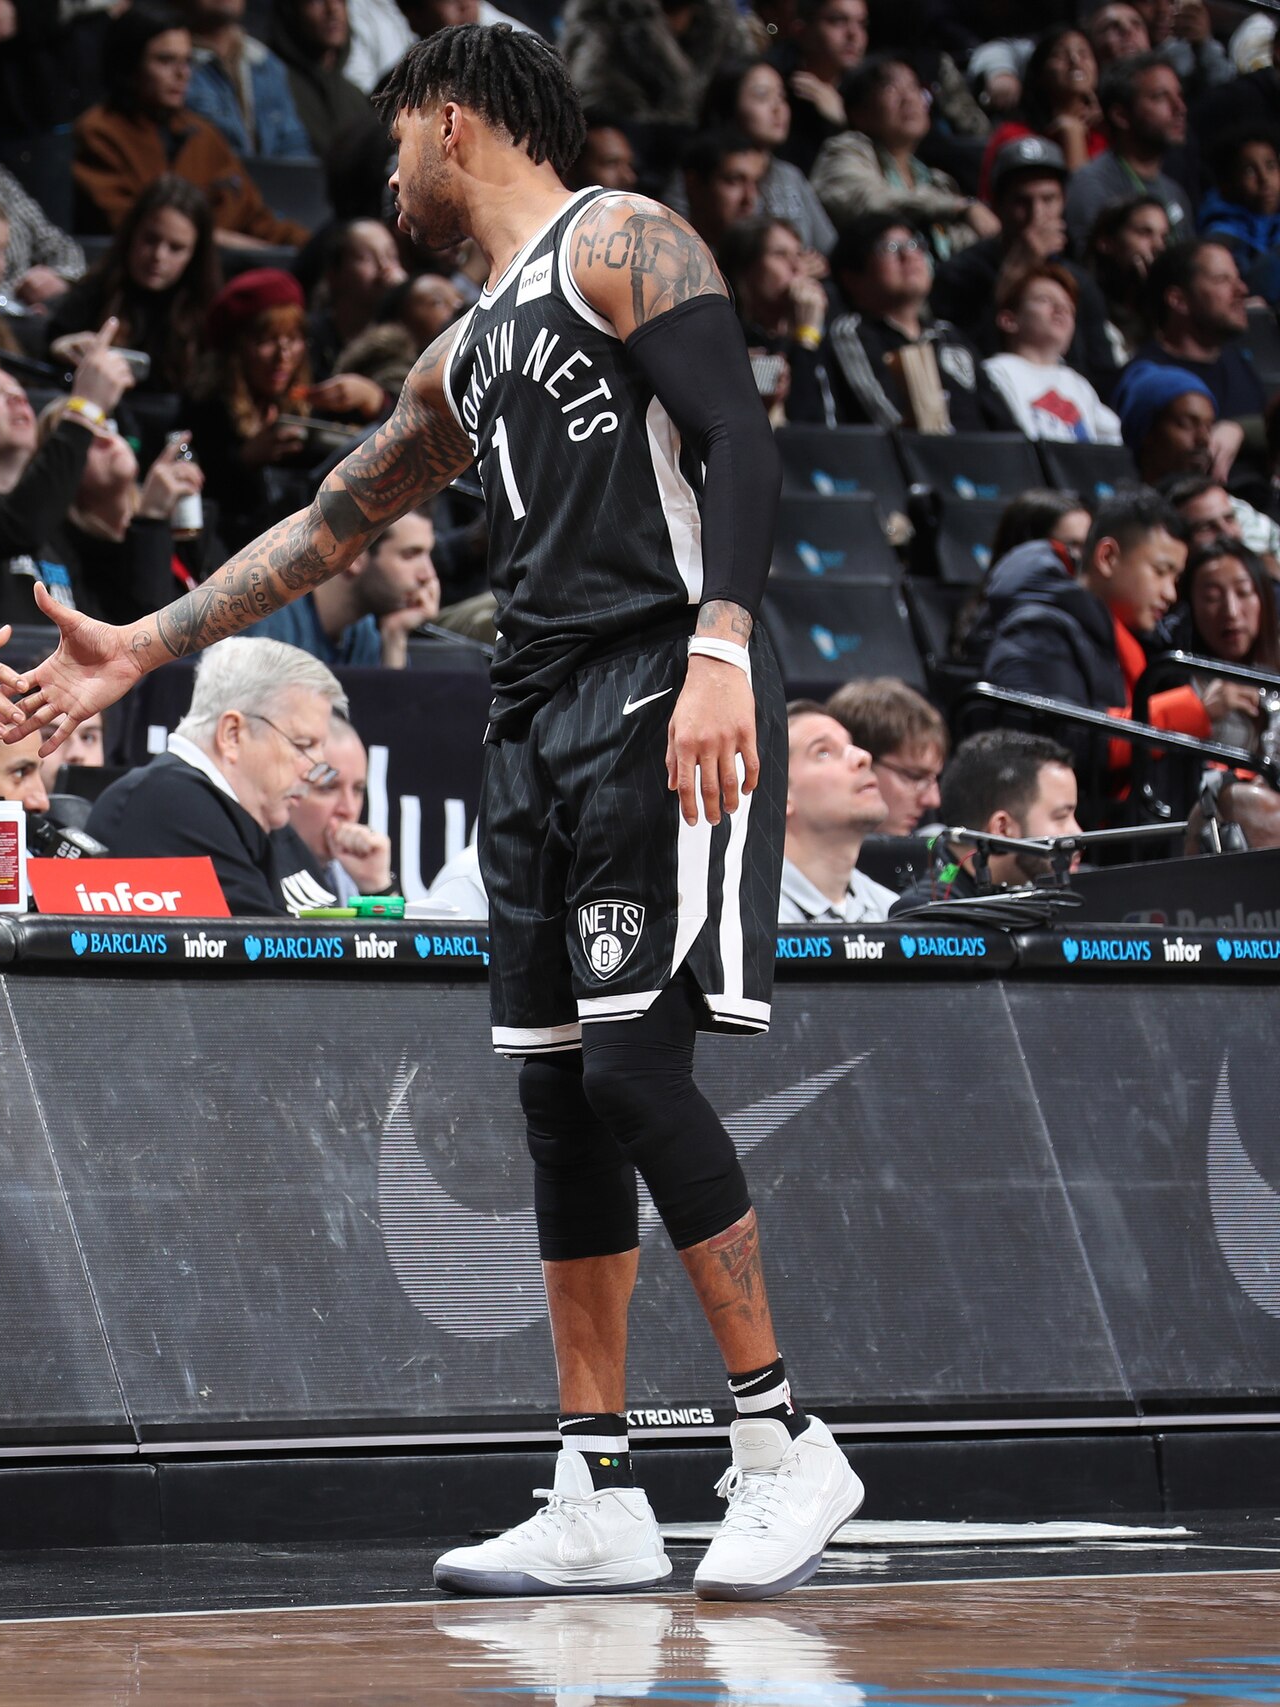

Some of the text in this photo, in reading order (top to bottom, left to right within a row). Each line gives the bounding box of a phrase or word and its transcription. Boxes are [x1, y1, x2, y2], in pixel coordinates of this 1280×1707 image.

[521, 266, 550, 290] infor
[522, 327, 619, 442] NETS
[491, 415, 526, 521] 1
[76, 881, 182, 912] infor
[581, 903, 639, 938] NETS
[90, 931, 489, 960] BARCLAYS infor BARCLAYS infor BARCL
[600, 939, 610, 967] B
[842, 934, 885, 960] infor
[917, 936, 987, 957] BARCLAYS
[1080, 939, 1152, 962] BARCLAYS
[1162, 936, 1202, 962] infor
